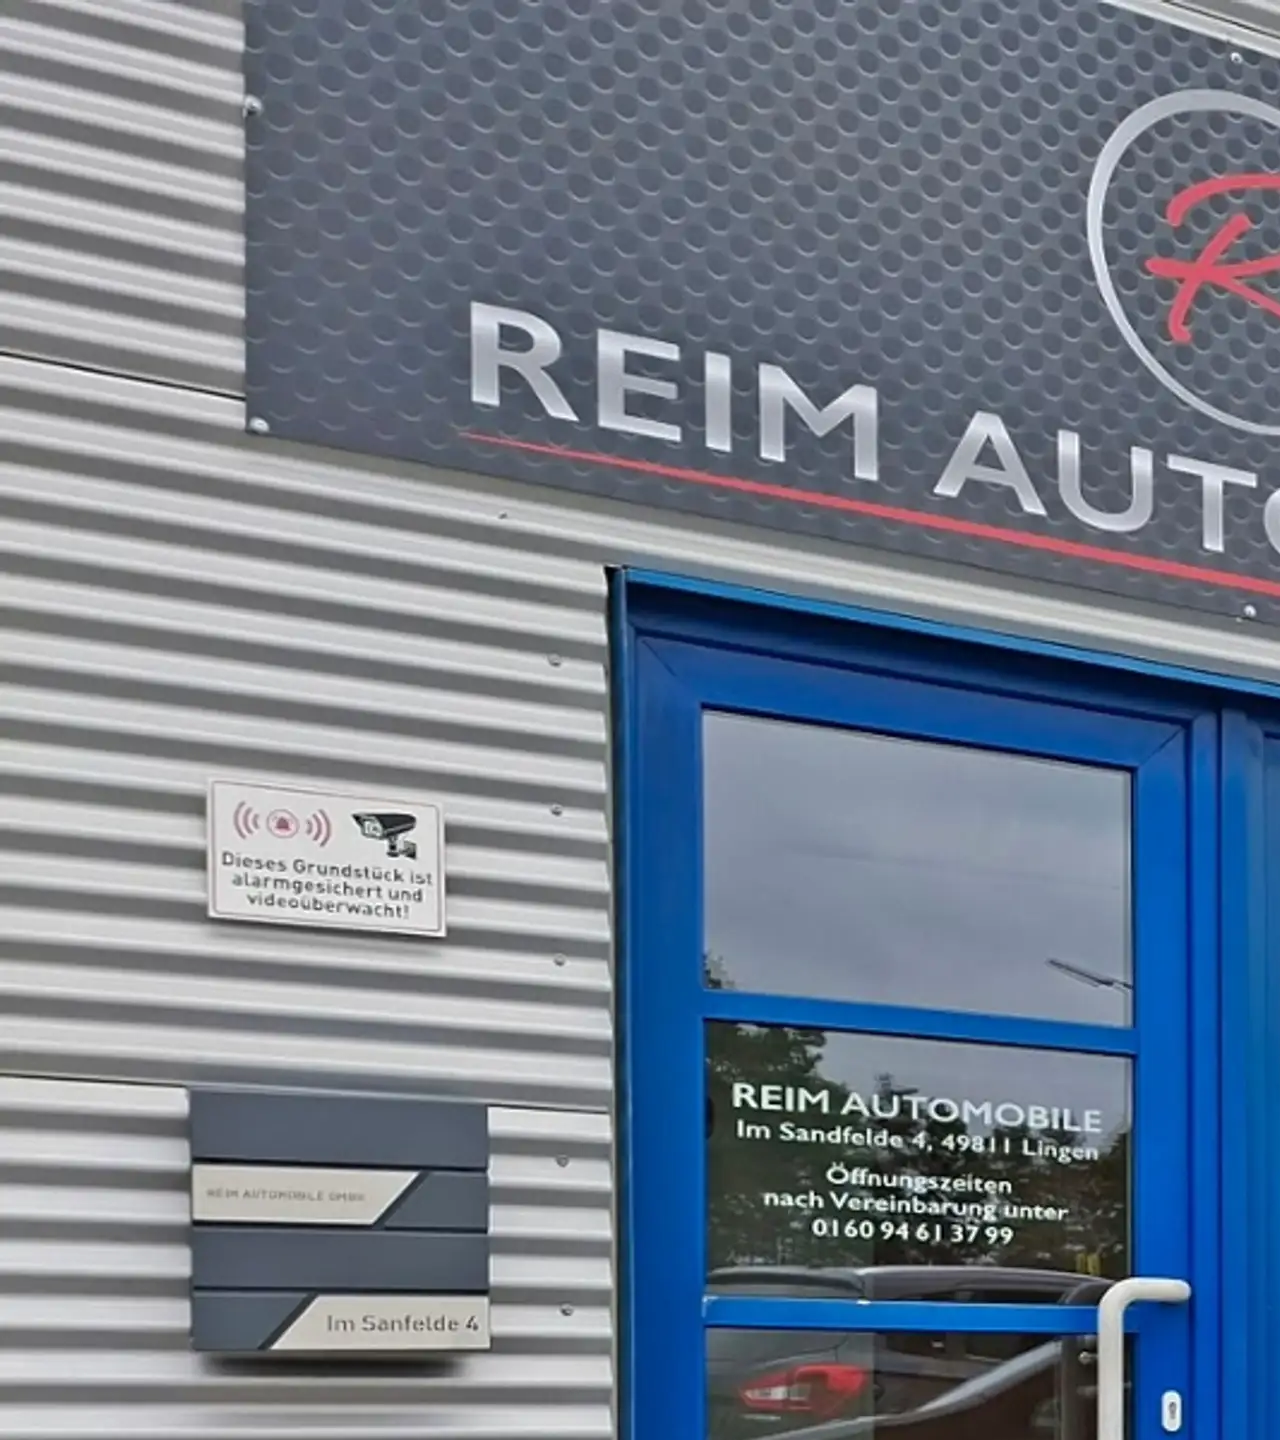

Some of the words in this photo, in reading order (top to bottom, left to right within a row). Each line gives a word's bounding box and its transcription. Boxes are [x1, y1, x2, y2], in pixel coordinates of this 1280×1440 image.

[470, 301, 879, 481] REIM
[221, 851, 287, 872] Dieses
[293, 858, 405, 884] Grundstück
[409, 870, 433, 886] ist
[231, 871, 382, 900] alarmgesichert
[388, 888, 423, 903] und
[246, 891, 410, 920] videoüberwacht!
[732, 1082, 830, 1114] REIM
[840, 1090, 1102, 1133] AUTOMOBILE
[736, 1119, 771, 1141] Im
[779, 1121, 903, 1149] Sandfelde
[911, 1132, 933, 1153] 4,
[940, 1134, 1012, 1156] 49811
[1021, 1138, 1100, 1163] Lingen
[826, 1161, 1013, 1196] Öffnungszeiten
[763, 1190, 824, 1210] nach
[829, 1190, 998, 1222] Vereinbarung
[1003, 1202, 1069, 1222] unter
[811, 1219, 874, 1240] 0160
[880, 1220, 909, 1241] 94
[916, 1222, 942, 1242] 61
[949, 1223, 979, 1244] 37
[985, 1224, 1014, 1246] 99
[326, 1314, 355, 1332] Im
[361, 1314, 460, 1333] Sanfelde
[465, 1316, 480, 1332] 4
